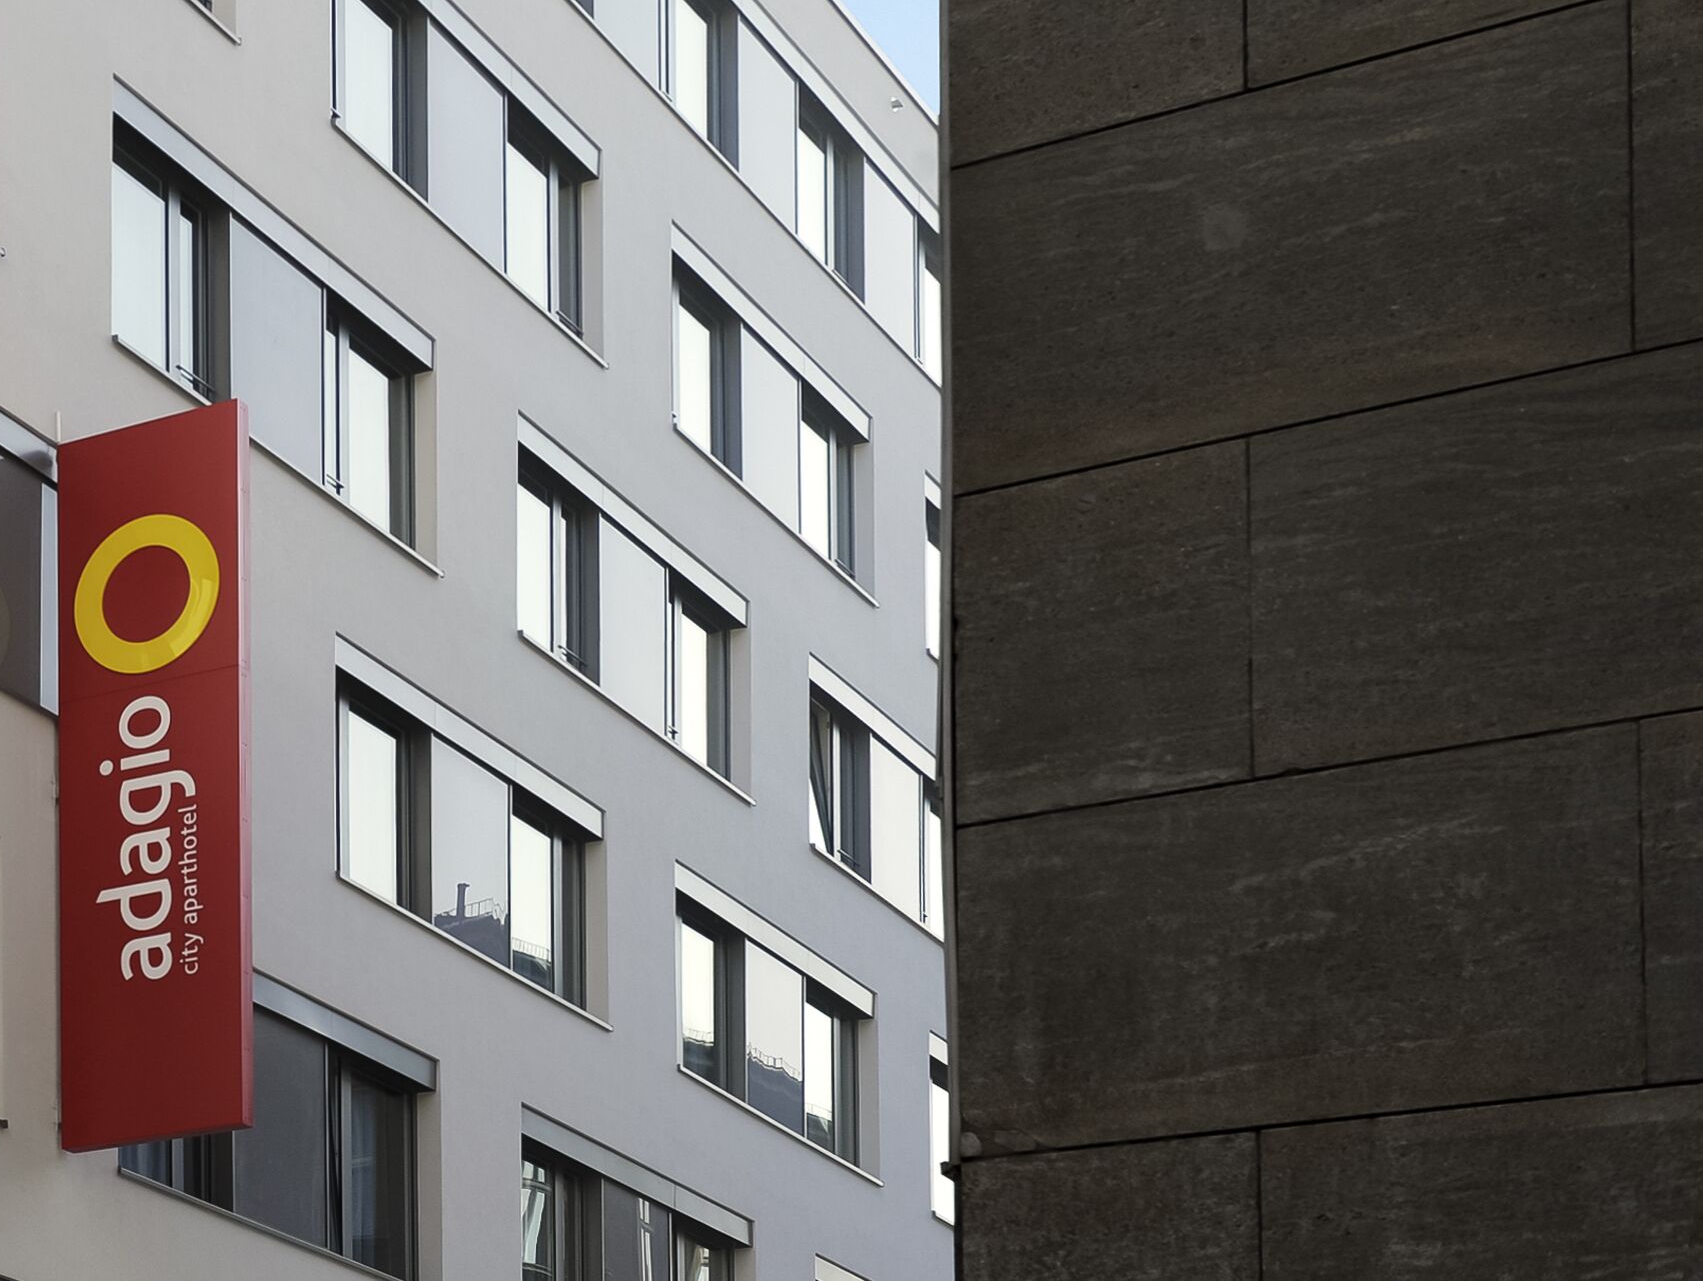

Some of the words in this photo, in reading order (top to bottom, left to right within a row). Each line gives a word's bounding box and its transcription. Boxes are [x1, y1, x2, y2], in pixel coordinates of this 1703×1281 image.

[96, 695, 197, 981] adagio
[178, 804, 204, 925] aparthotel
[179, 932, 204, 975] city
